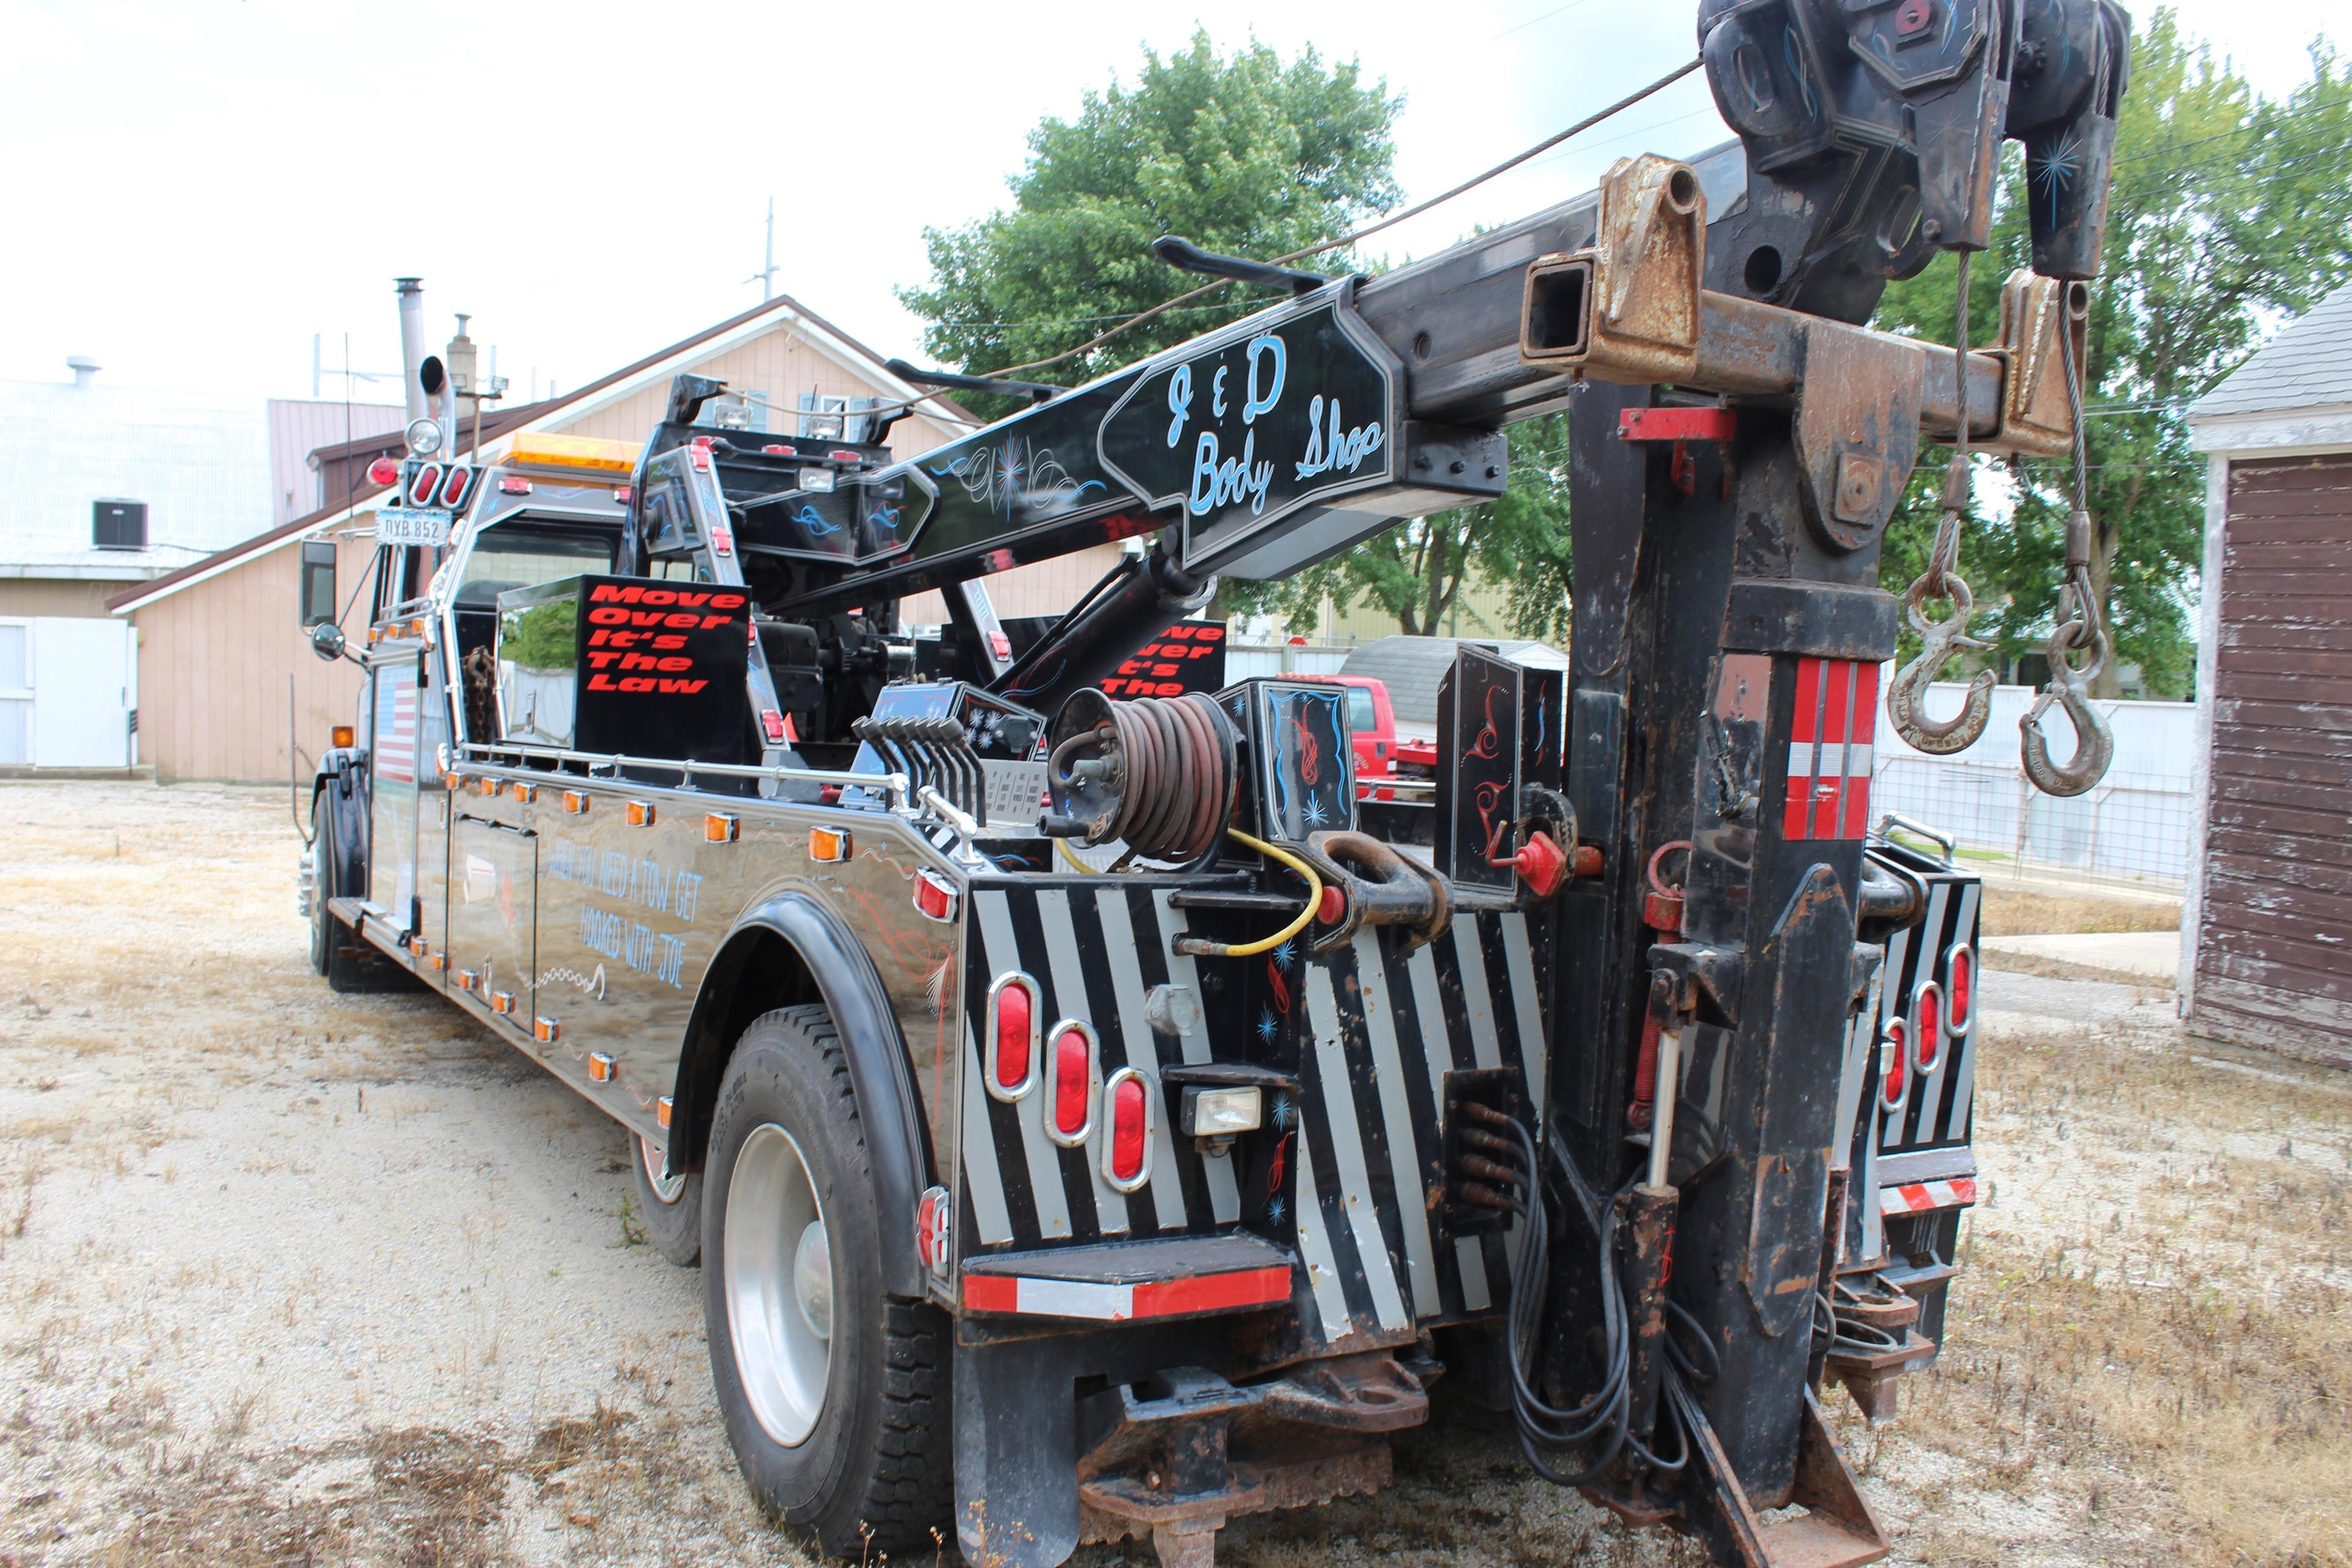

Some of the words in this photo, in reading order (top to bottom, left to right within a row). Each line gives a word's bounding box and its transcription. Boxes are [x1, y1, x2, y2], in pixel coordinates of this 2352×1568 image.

[1167, 364, 1194, 449] J
[1242, 333, 1287, 425] D
[1188, 428, 1275, 516] Body
[1294, 394, 1385, 481] Shop
[415, 521, 439, 538] 852
[589, 585, 745, 609] Move
[588, 607, 733, 630] Over
[587, 629, 689, 650] It's
[587, 651, 693, 672] The
[1137, 644, 1214, 658] ver
[1117, 660, 1180, 676] t's
[587, 673, 709, 694] Law
[1099, 678, 1184, 696] The
[599, 850, 628, 898] NEED
[630, 859, 638, 902] A
[641, 859, 671, 912] TOW
[675, 870, 703, 923] GET
[579, 903, 621, 959] HOOKED
[624, 919, 655, 974] WITH
[658, 933, 686, 990] JOE
